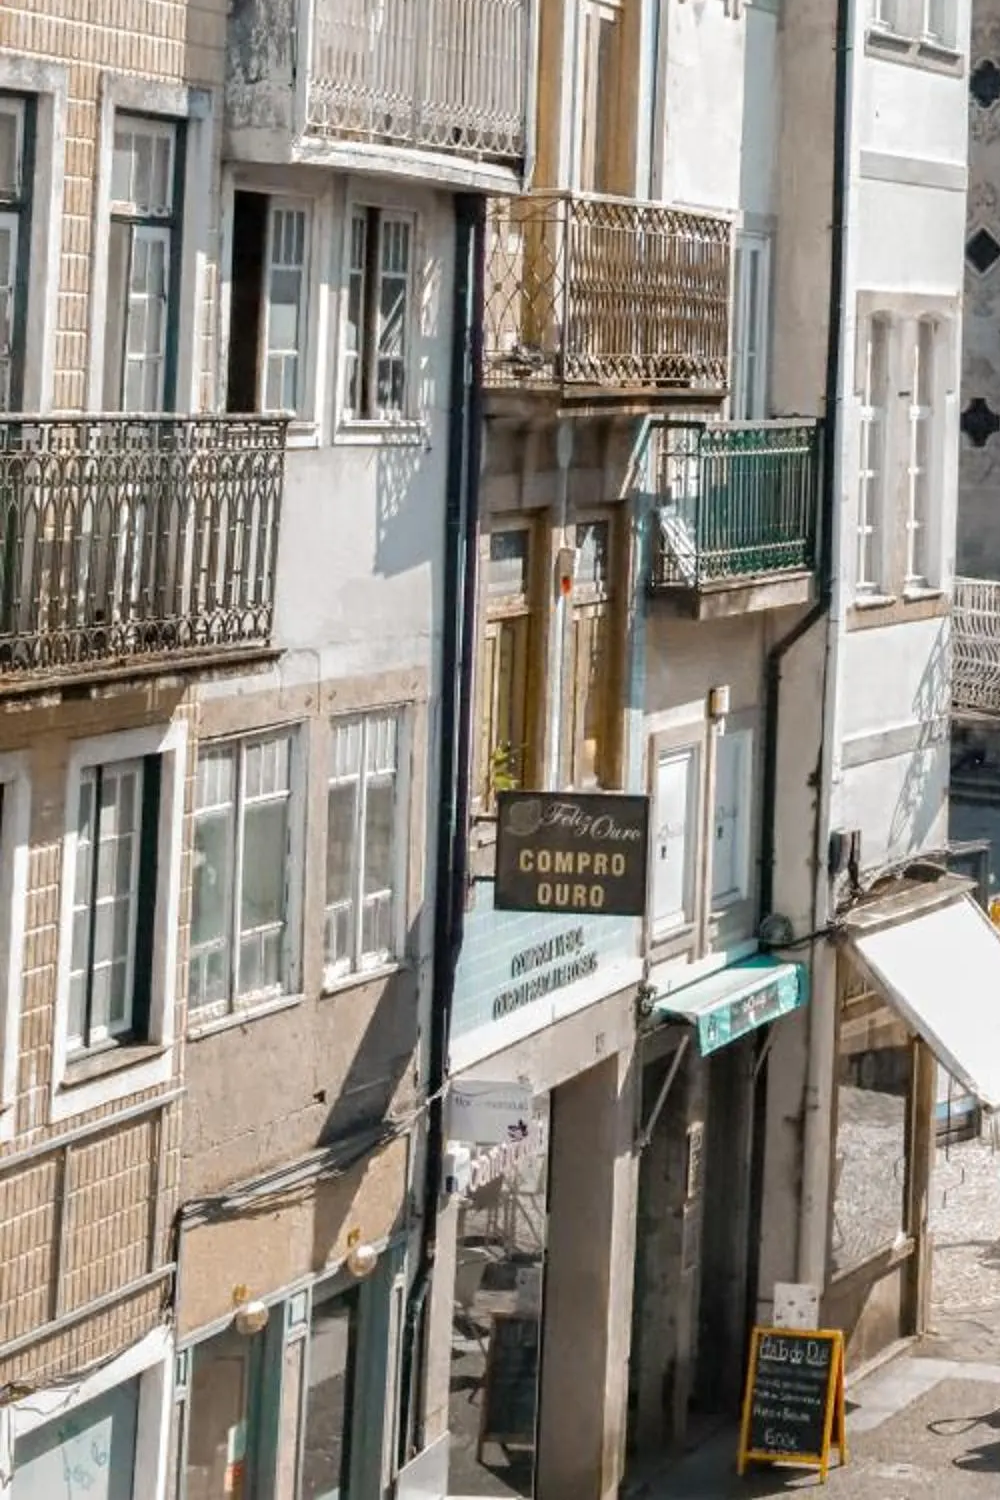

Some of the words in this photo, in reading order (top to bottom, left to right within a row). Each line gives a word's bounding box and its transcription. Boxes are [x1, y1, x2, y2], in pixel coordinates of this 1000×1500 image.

[544, 802, 593, 837] Feliz
[589, 815, 641, 840] Ouro
[519, 849, 626, 877] COMPRO
[537, 882, 605, 908] OURO
